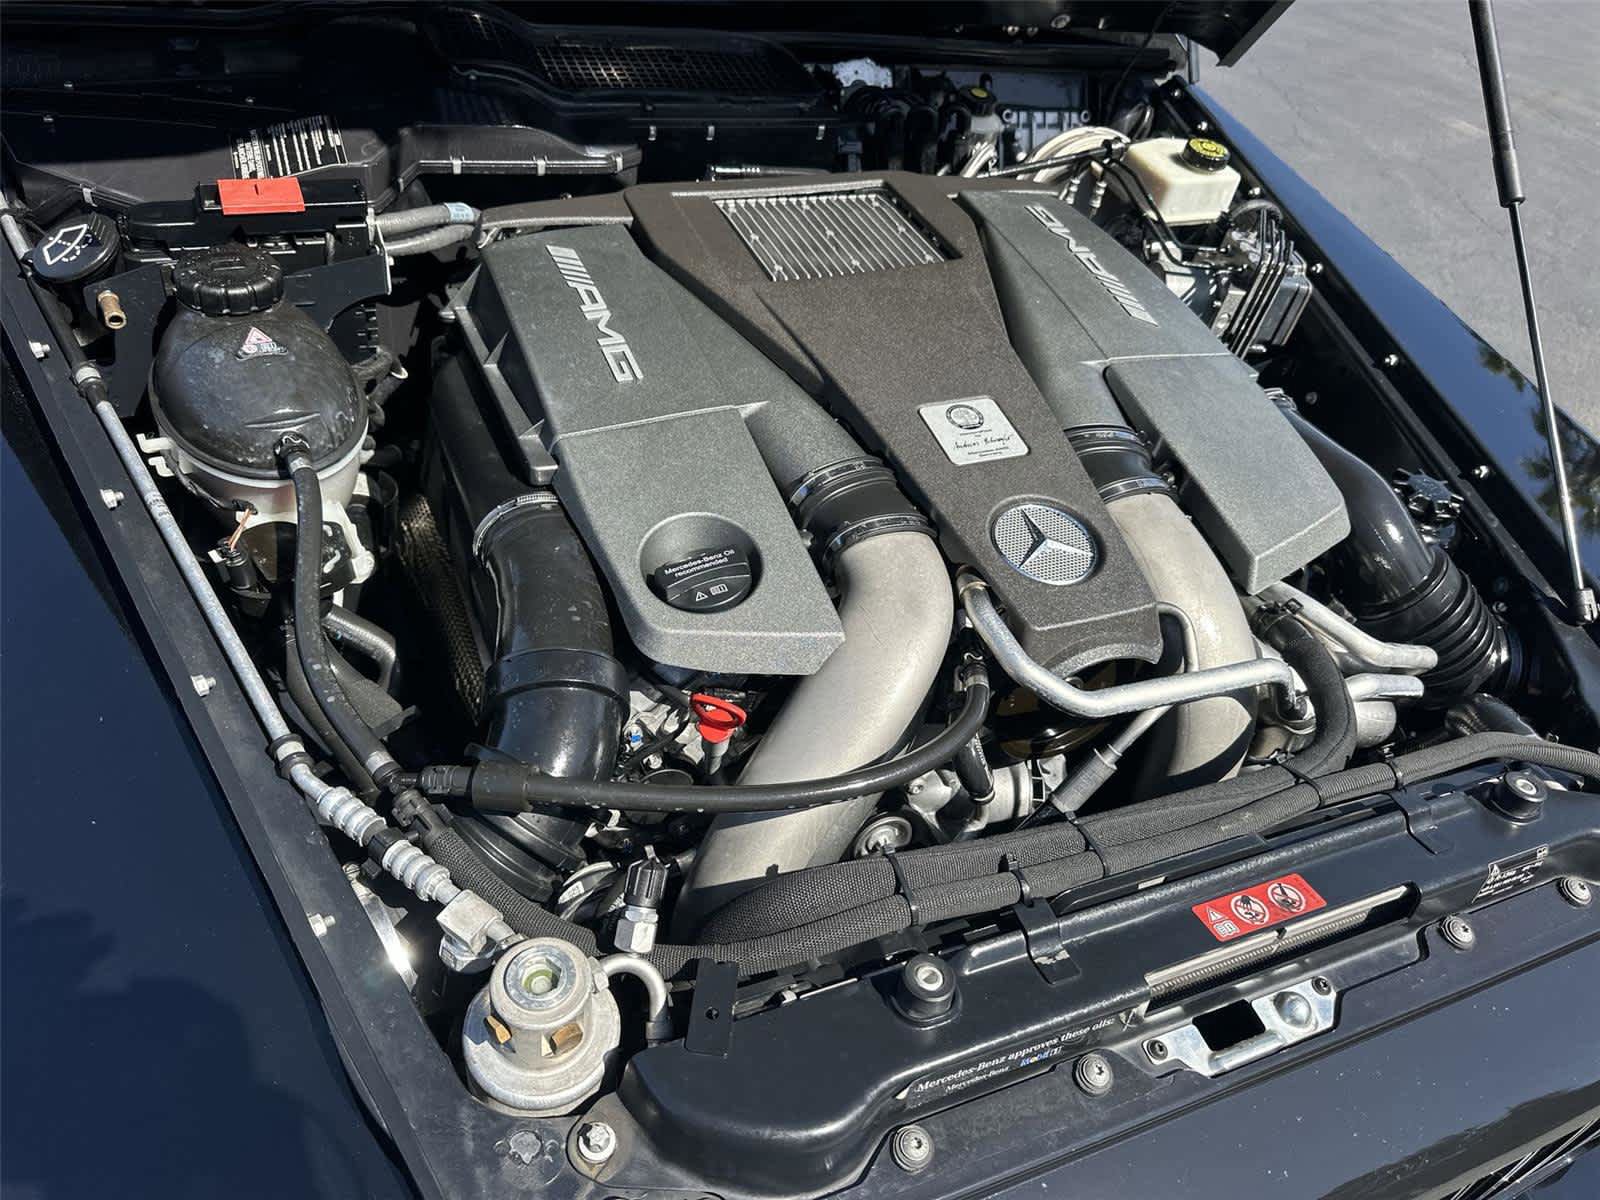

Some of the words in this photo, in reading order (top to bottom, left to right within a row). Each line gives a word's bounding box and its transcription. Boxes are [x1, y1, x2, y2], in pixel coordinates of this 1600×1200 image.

[566, 280, 644, 382] AMG
[664, 553, 723, 575] Mercedes-Benz
[675, 557, 729, 578] recommended
[914, 1057, 1007, 1092] Mercedes-Benz
[1008, 1038, 1059, 1060] approves
[1060, 1027, 1090, 1042] these
[1092, 1018, 1115, 1031] oils:
[1020, 1050, 1050, 1066] Mobil
